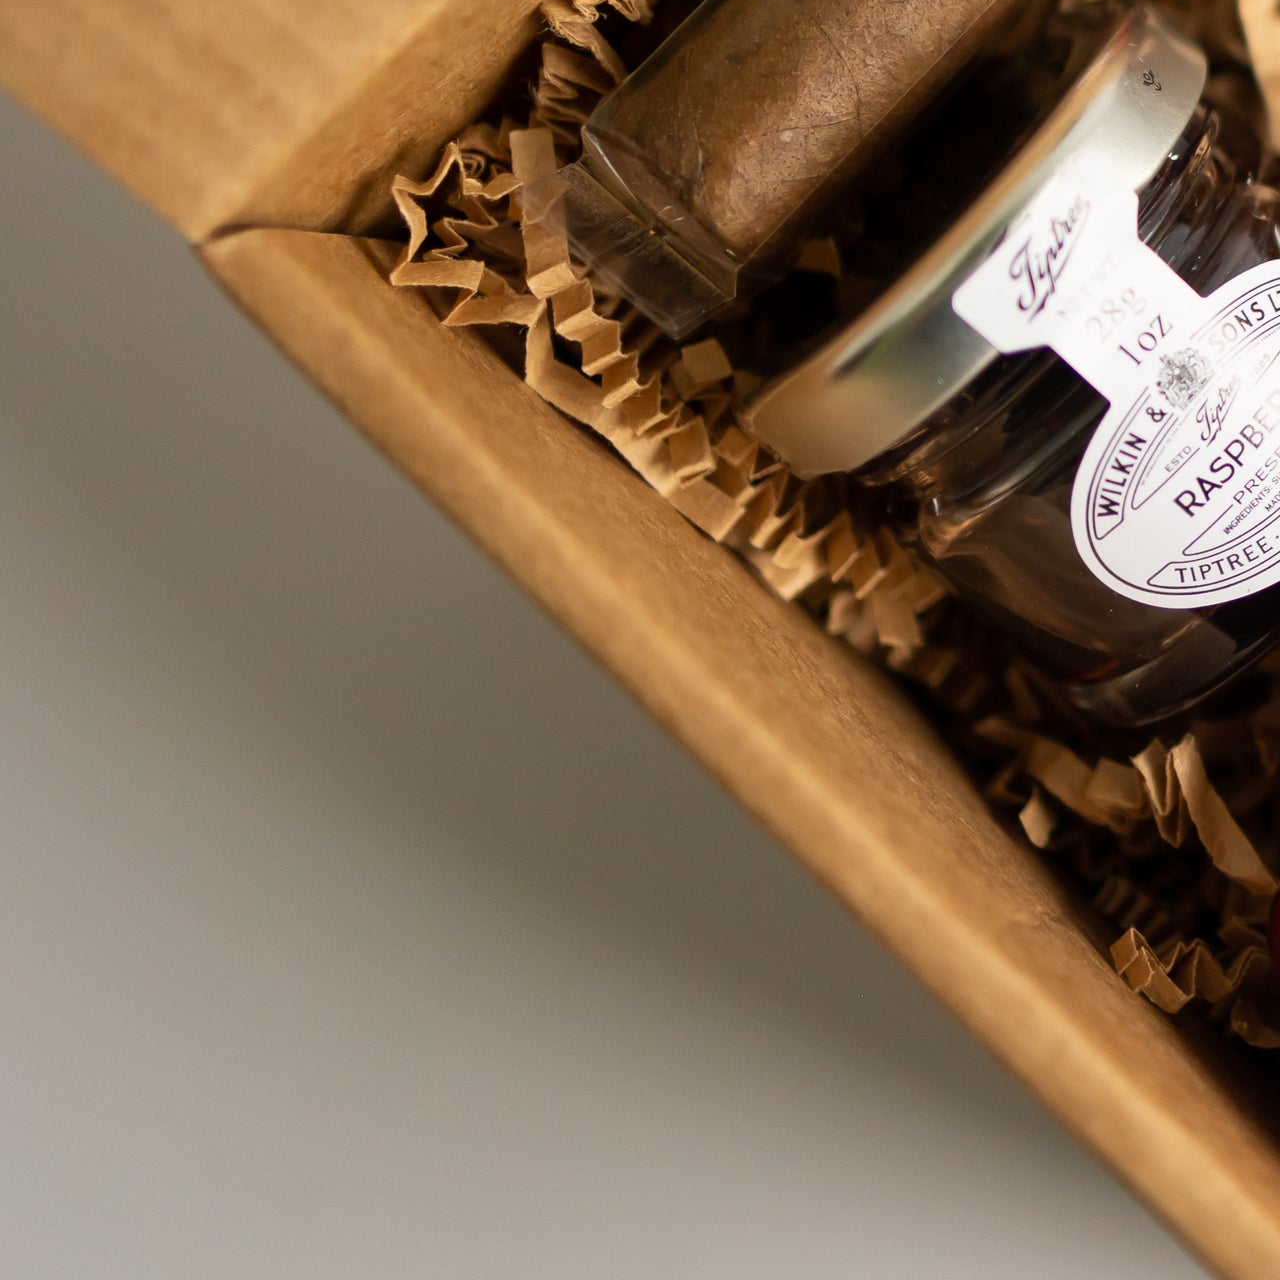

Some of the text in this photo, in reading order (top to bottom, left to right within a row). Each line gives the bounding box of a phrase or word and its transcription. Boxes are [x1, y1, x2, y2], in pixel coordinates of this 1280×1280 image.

[1085, 284, 1146, 343] 28g
[1096, 432, 1146, 516] WILKIN
[1145, 405, 1167, 422] &
[1205, 300, 1265, 355] SONS
[1164, 445, 1191, 472] ESTD
[1222, 486, 1270, 534] INGREDIENTS:
[1174, 535, 1273, 583] TIPTREE
